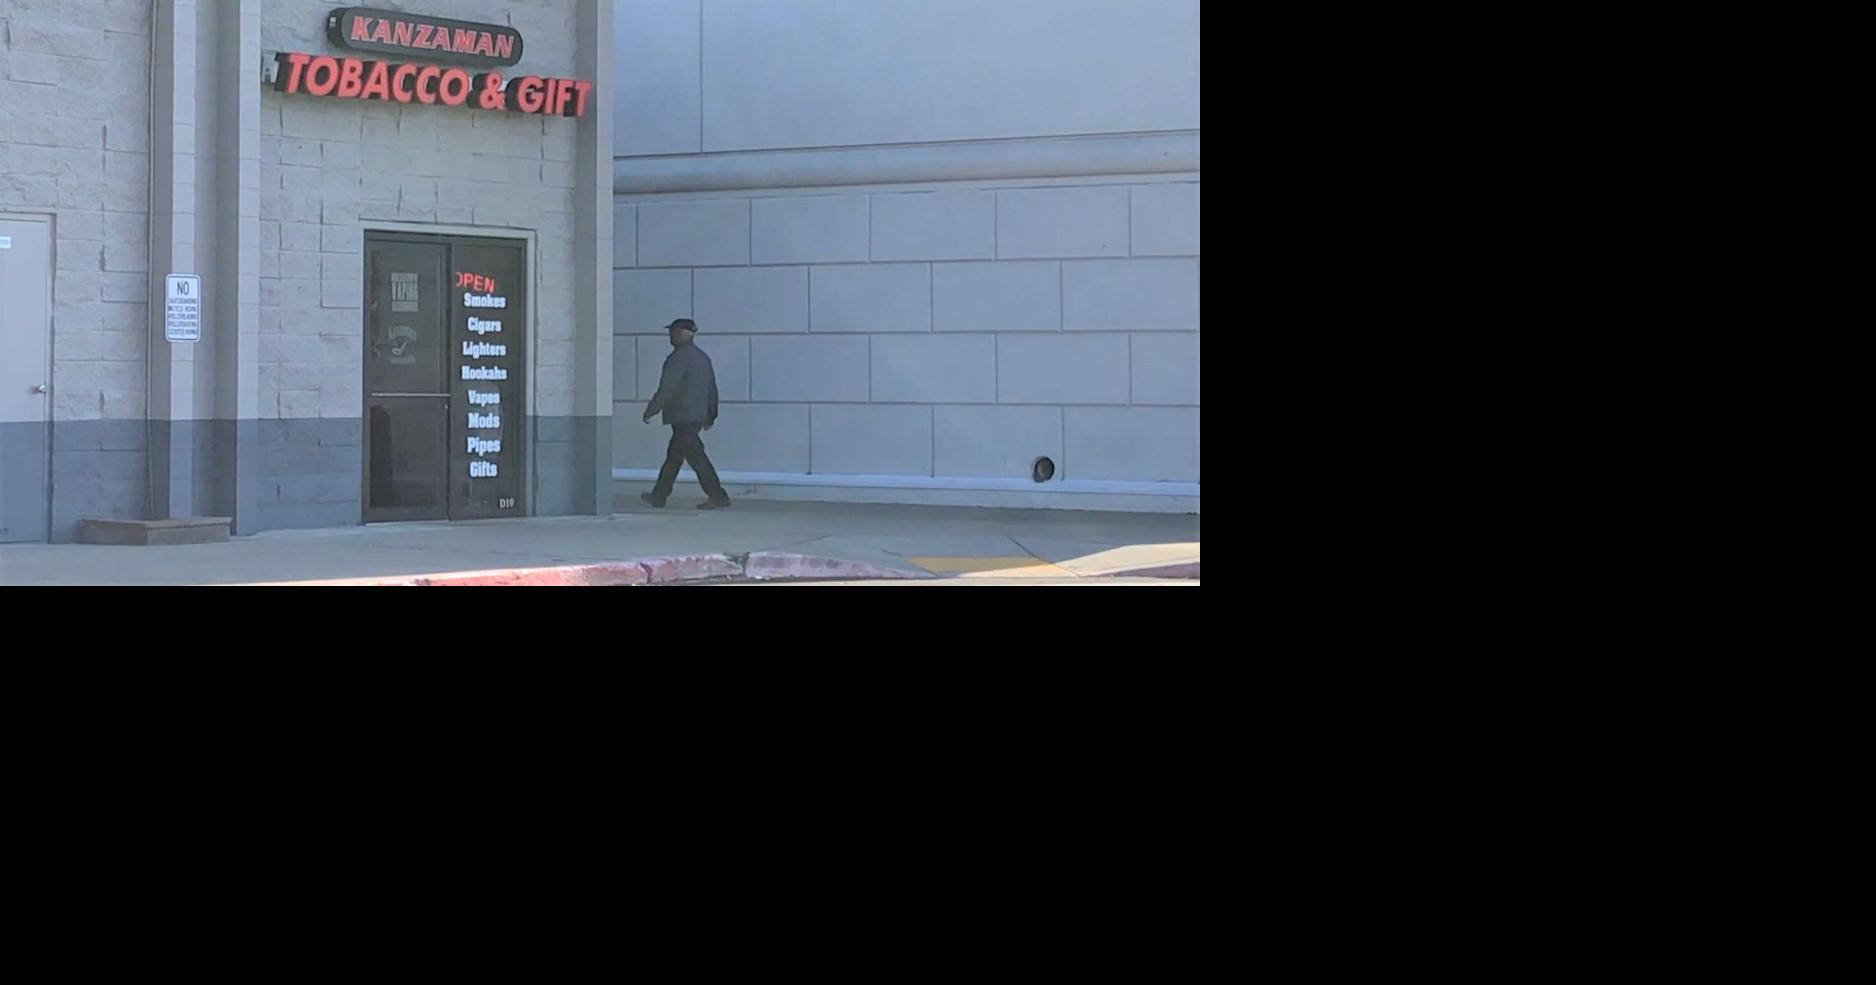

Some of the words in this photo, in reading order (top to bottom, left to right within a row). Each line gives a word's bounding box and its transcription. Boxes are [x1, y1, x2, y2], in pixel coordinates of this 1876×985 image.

[350, 15, 516, 59] KANZAMAN
[286, 52, 470, 106] TOBACCO
[480, 73, 506, 110] &
[517, 75, 593, 117] GIFT
[177, 281, 190, 295] NO
[463, 292, 506, 308] Smokes
[467, 316, 502, 335] Cigars
[462, 341, 506, 359] Lighters
[461, 365, 507, 380] Hookahs
[467, 389, 500, 407] Vapes
[467, 412, 500, 429] Mods
[466, 436, 501, 456] Pipes
[469, 461, 498, 477] Gifts
